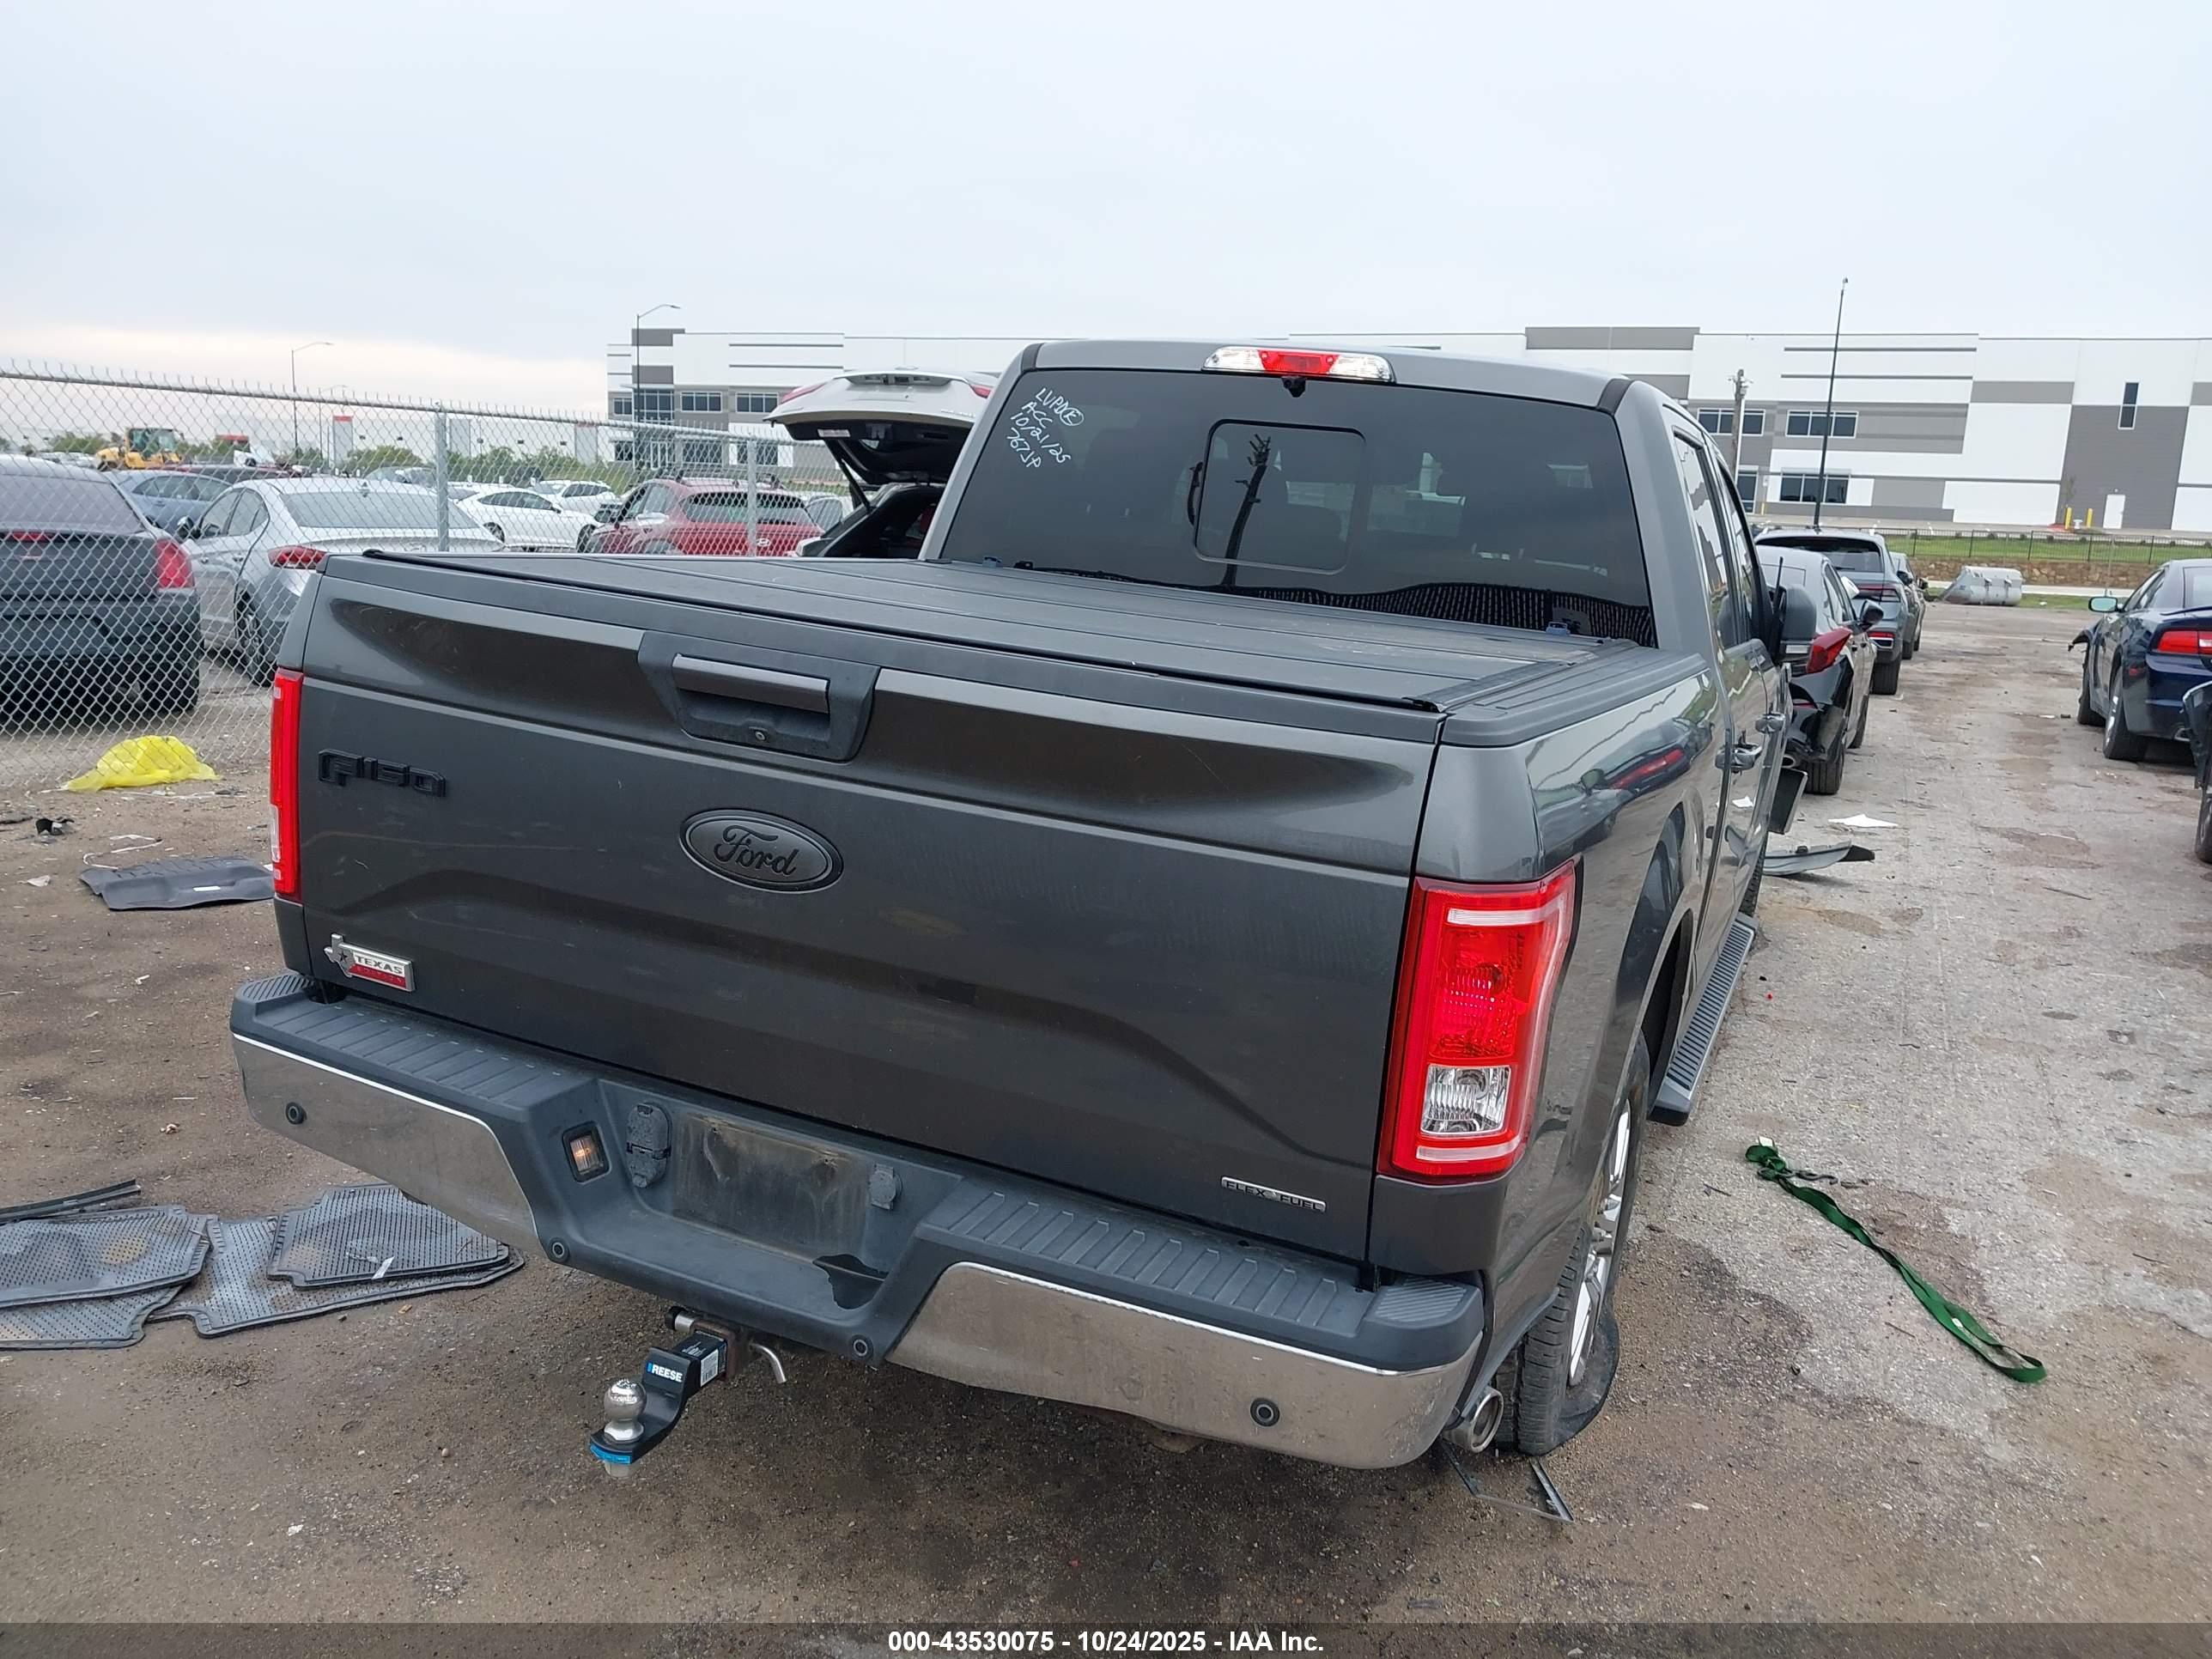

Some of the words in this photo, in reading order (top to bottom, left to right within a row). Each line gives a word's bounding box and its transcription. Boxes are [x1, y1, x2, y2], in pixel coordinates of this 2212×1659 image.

[1022, 401, 1053, 428] ACC
[1011, 412, 1072, 463] 10/21/25
[714, 824, 799, 876] Ford
[355, 955, 403, 975] TEXAS
[1225, 1180, 1267, 1197] FLEX
[1279, 1194, 1324, 1212] FUEL
[651, 1362, 684, 1383] REESE
